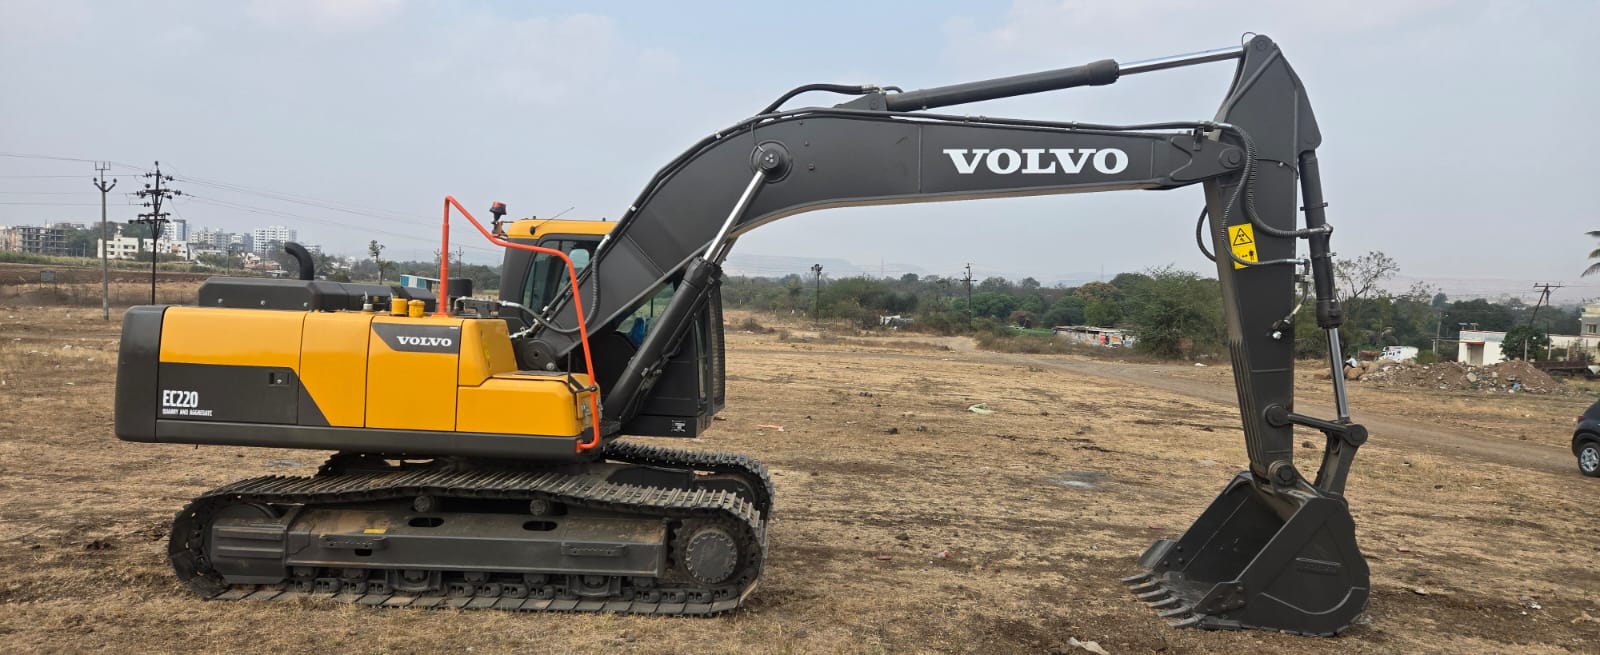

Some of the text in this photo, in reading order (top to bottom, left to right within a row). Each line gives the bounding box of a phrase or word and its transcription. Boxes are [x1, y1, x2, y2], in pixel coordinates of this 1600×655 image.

[943, 147, 1129, 175] VOLVO
[396, 336, 452, 347] VOLVO
[162, 389, 199, 408] EC220
[179, 408, 189, 416] AND
